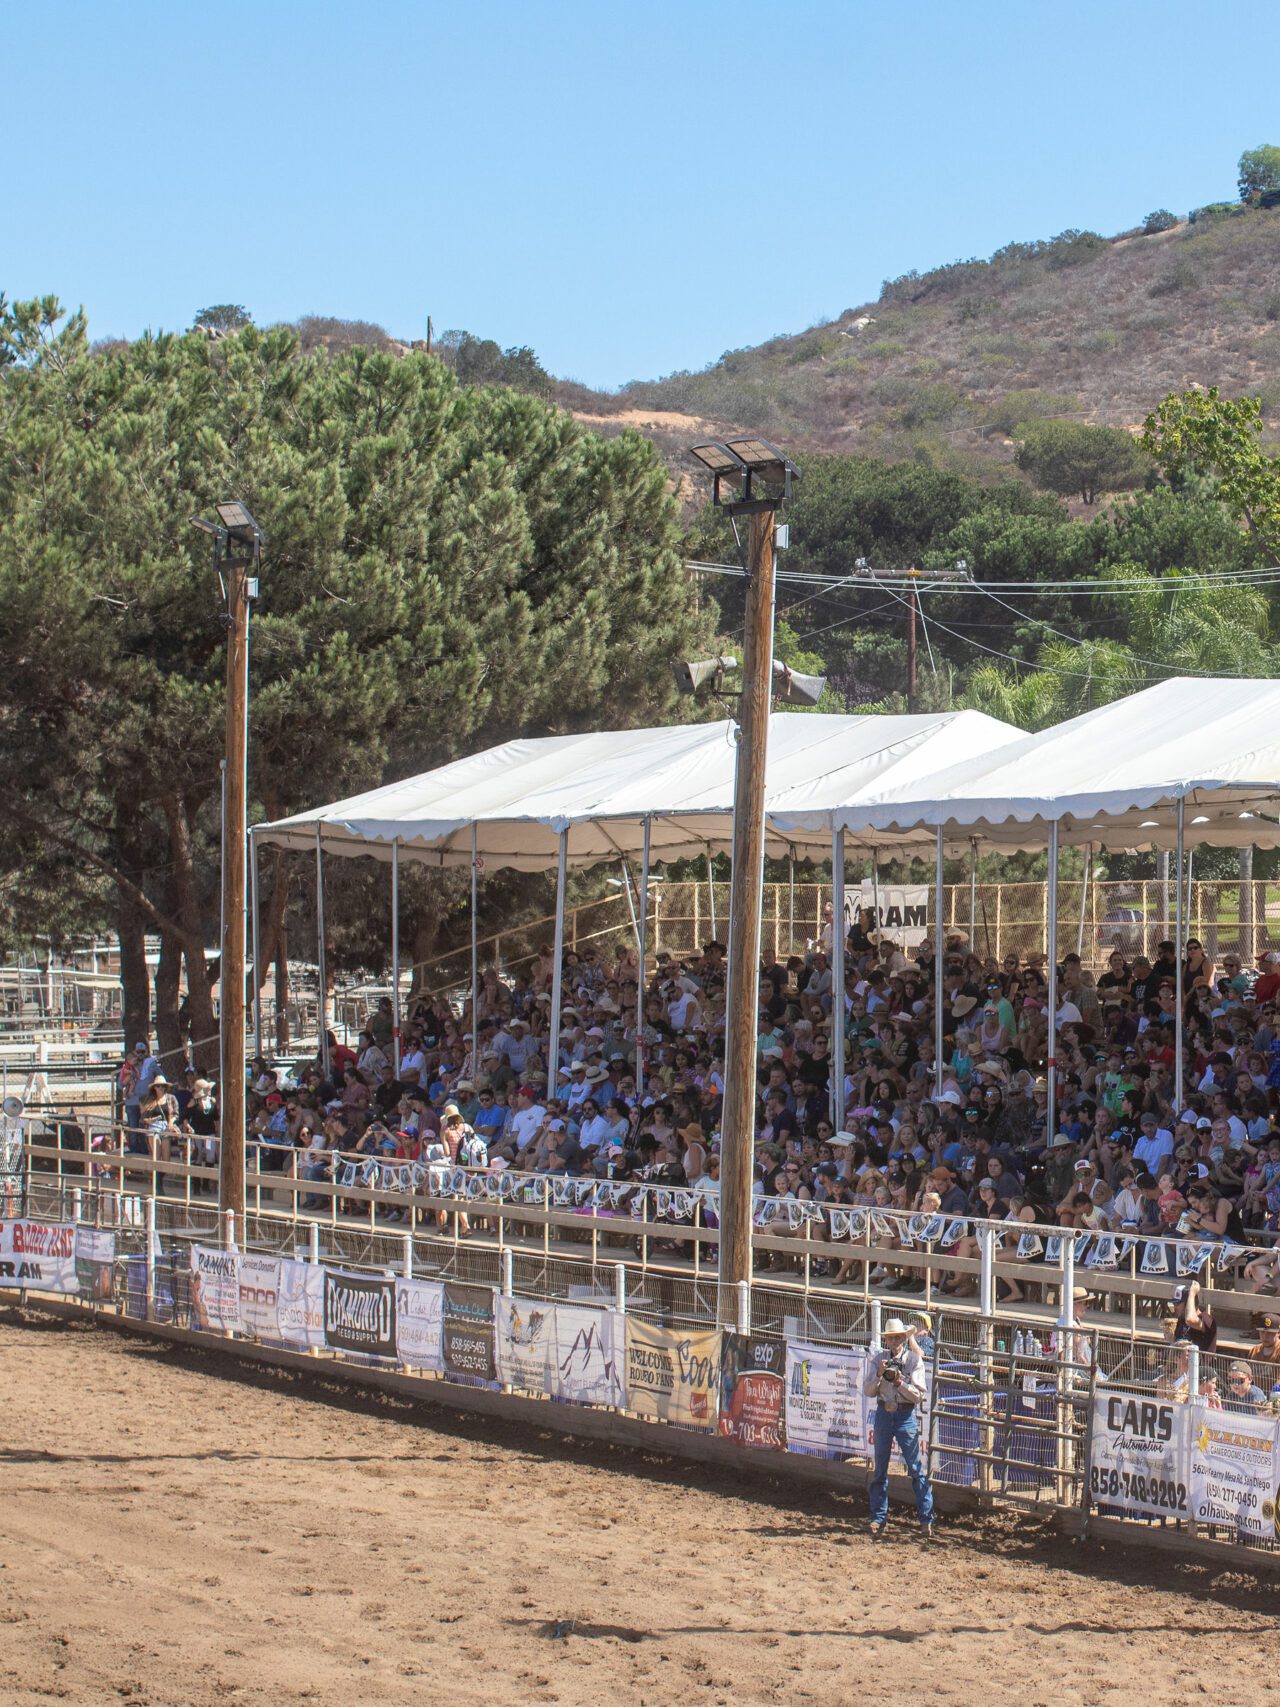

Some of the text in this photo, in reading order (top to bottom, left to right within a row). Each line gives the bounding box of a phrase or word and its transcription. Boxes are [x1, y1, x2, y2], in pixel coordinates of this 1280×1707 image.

[198, 1253, 236, 1277] RAMONA
[242, 1257, 260, 1270] Services
[1018, 1250, 1041, 1258] RAM
[240, 1285, 276, 1307] EDCO
[327, 1277, 380, 1332] DIAMOND
[380, 1286, 392, 1342] D
[629, 1347, 674, 1372] WELCOME
[630, 1366, 674, 1388] RODEO FANS
[1107, 1396, 1173, 1441] CARS
[1113, 1434, 1165, 1453] Automotive
[1206, 1428, 1274, 1452] OLHAUSEN
[1253, 1476, 1271, 1490] Diego
[1223, 1486, 1257, 1508] 277-0450
